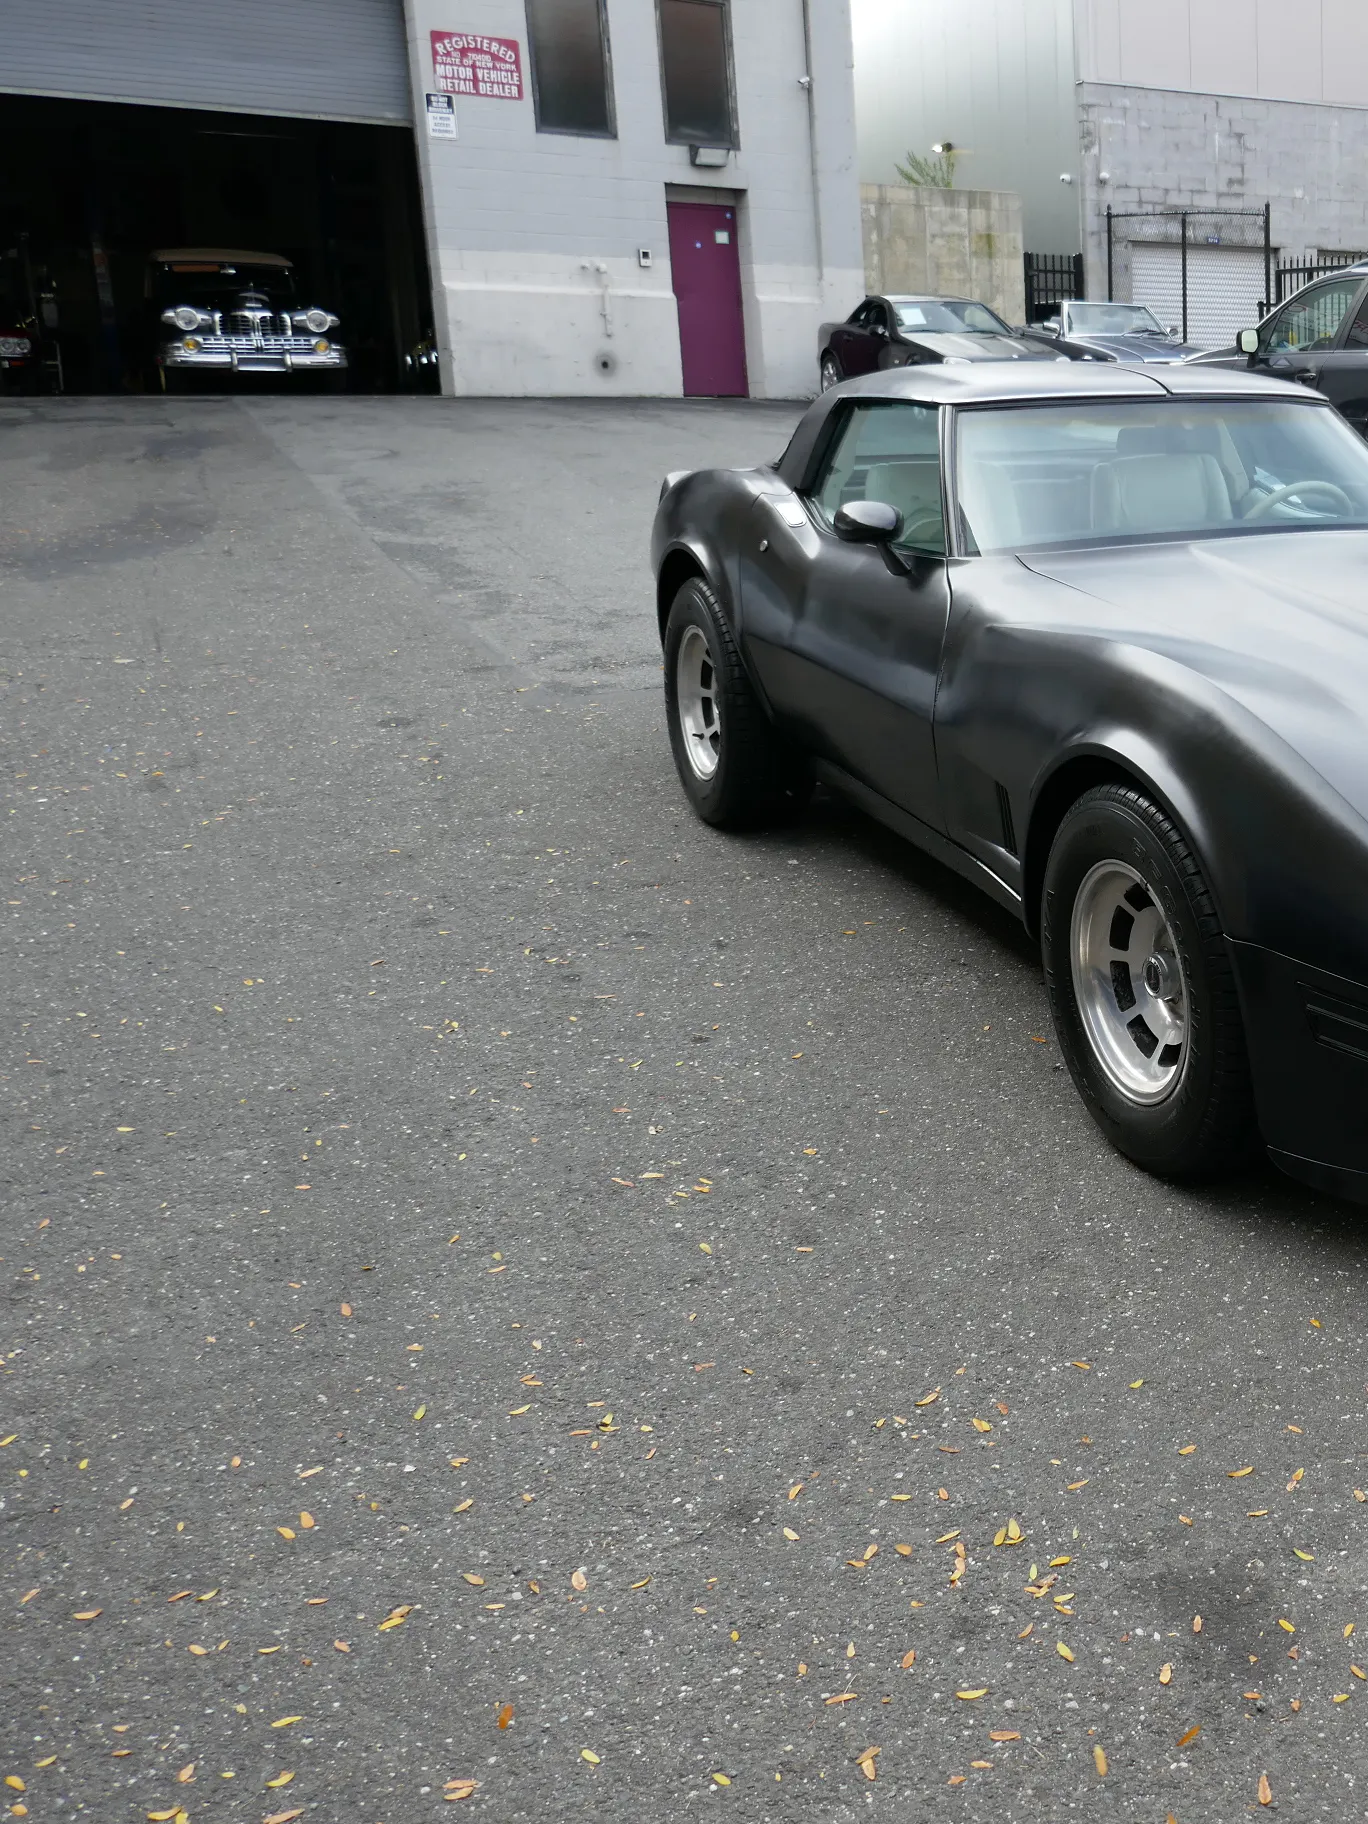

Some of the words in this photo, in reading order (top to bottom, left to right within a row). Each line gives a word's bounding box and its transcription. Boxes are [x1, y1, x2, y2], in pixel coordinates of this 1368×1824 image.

[435, 36, 516, 62] REGISTERED
[436, 56, 461, 65] STATE
[463, 59, 473, 67] OF
[476, 61, 494, 69] NEW
[496, 62, 517, 71] YORK
[435, 64, 473, 80] MOTOR
[476, 68, 521, 85] VEHICLE
[439, 78, 476, 94] RETAIL
[479, 82, 519, 98] DEALER
